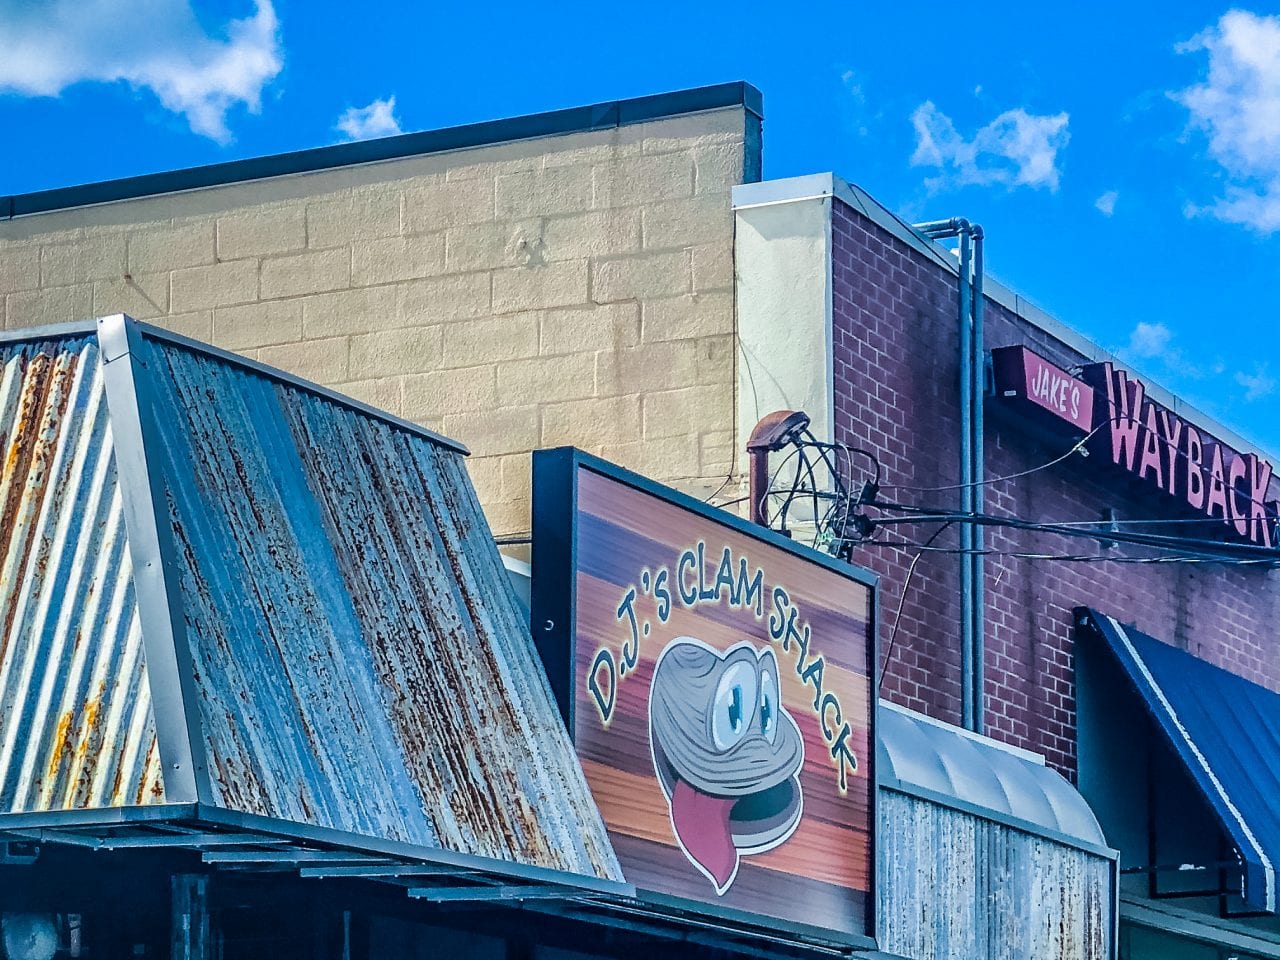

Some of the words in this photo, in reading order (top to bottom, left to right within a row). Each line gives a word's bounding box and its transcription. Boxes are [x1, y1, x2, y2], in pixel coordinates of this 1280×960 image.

[1031, 365, 1081, 420] JAKE'S
[1104, 361, 1273, 549] WAYBACK
[677, 540, 763, 616] CLAM
[770, 587, 857, 792] SHACK
